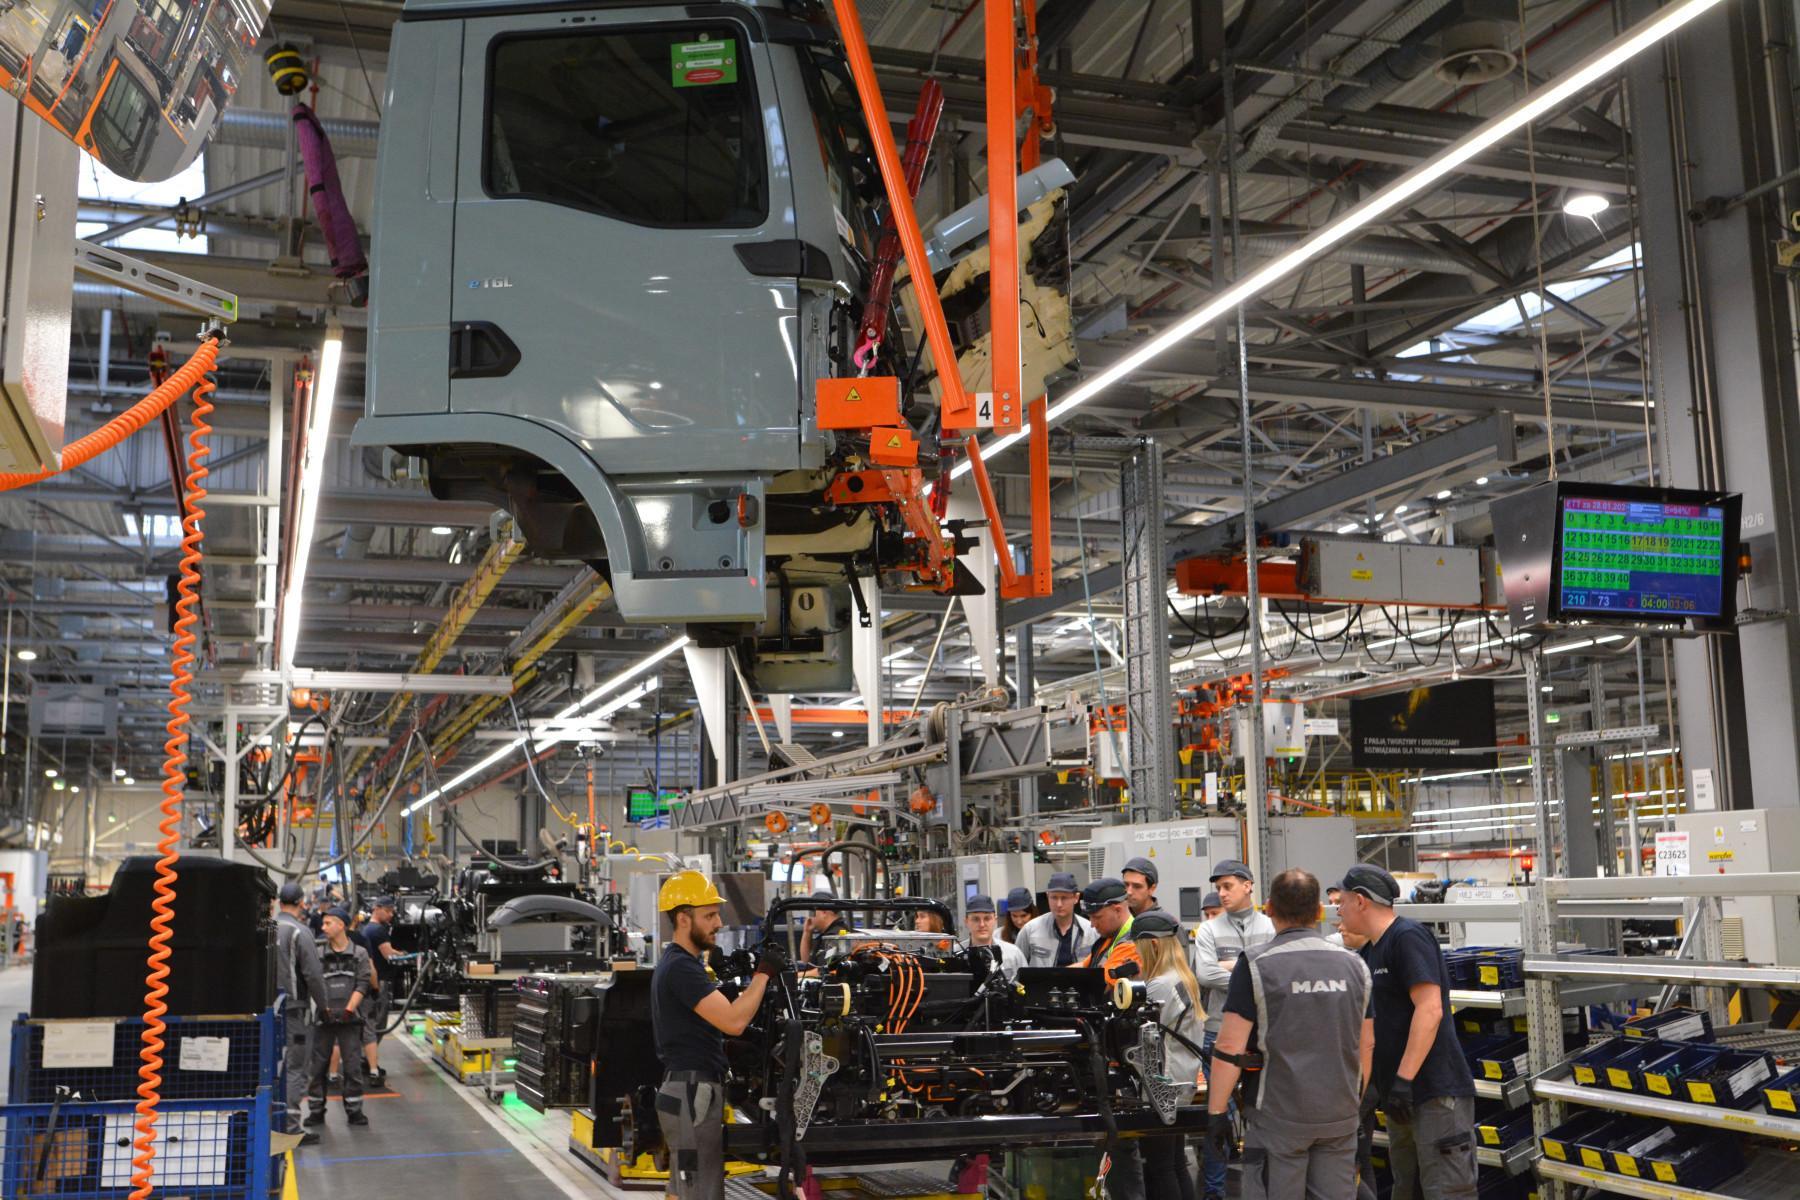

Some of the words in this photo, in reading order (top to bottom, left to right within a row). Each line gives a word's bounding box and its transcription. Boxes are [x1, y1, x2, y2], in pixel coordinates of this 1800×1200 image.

[979, 400, 991, 420] 4
[1566, 532, 1576, 542] 12
[1579, 532, 1590, 542] 13
[1592, 533, 1603, 543] 14
[1605, 534, 1617, 544] 15
[1619, 535, 1630, 545] 16
[1633, 535, 1643, 545] 17
[1646, 536, 1656, 546] 18
[1659, 537, 1669, 547] 19
[1671, 538, 1681, 548] 20
[1684, 538, 1694, 548] 21
[1697, 539, 1708, 549] 22
[1710, 540, 1720, 550] 23
[1564, 550, 1576, 560] 24
[1578, 551, 1589, 561] 25
[1591, 552, 1603, 562] 26
[1605, 553, 1616, 563] 27
[1618, 554, 1629, 564] 28
[1631, 554, 1643, 564] 29
[1644, 555, 1655, 565] 30
[1658, 556, 1668, 566] 31
[1671, 557, 1682, 567] 32
[1683, 557, 1694, 567] 33
[1696, 558, 1707, 568] 34
[1709, 559, 1719, 569] 35
[1565, 570, 1576, 580] 36
[1577, 571, 1588, 581] 37
[1591, 572, 1602, 582] 38
[1604, 572, 1615, 582] 39
[1617, 573, 1629, 583] 40
[1568, 594, 1585, 605] 210
[1598, 596, 1610, 607] 73
[1641, 597, 1668, 609] 04:00
[1658, 850, 1687, 859] C23625
[1291, 980, 1347, 993] MAN
